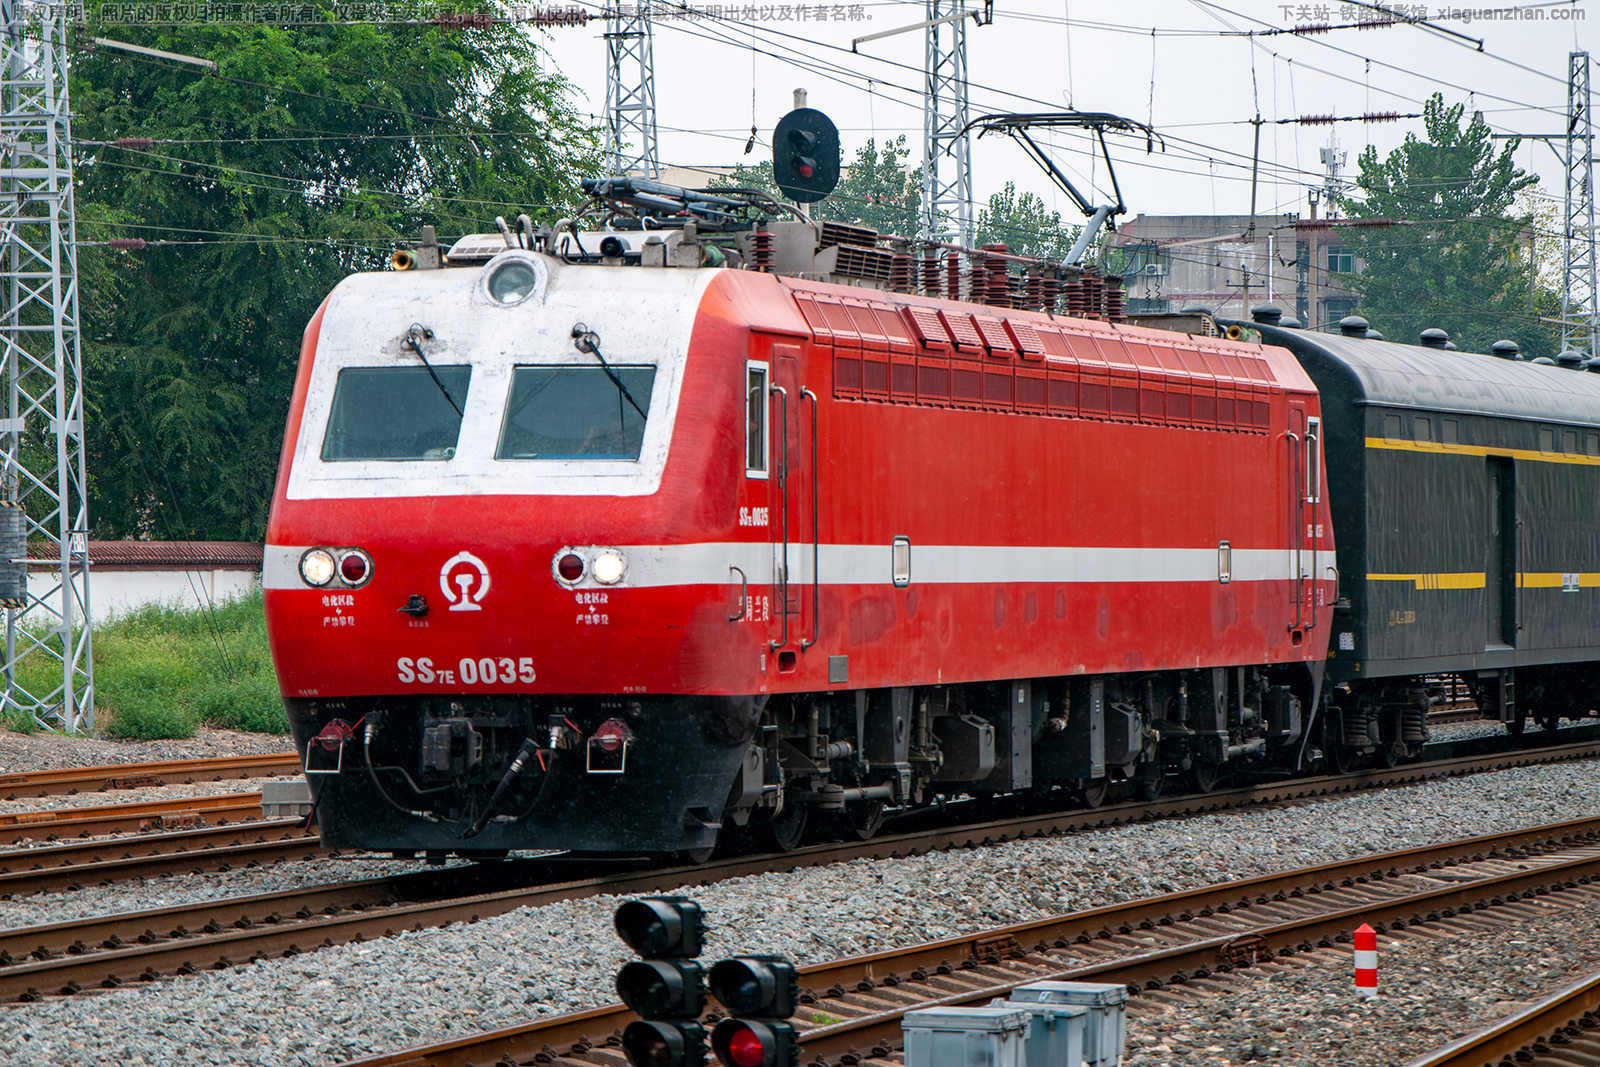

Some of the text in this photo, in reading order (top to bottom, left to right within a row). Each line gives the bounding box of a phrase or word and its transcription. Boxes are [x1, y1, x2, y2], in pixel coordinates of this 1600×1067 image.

[322, 595, 354, 607] 电化区段
[575, 592, 609, 604] 电化区段
[397, 657, 536, 684] SS7E 0035
